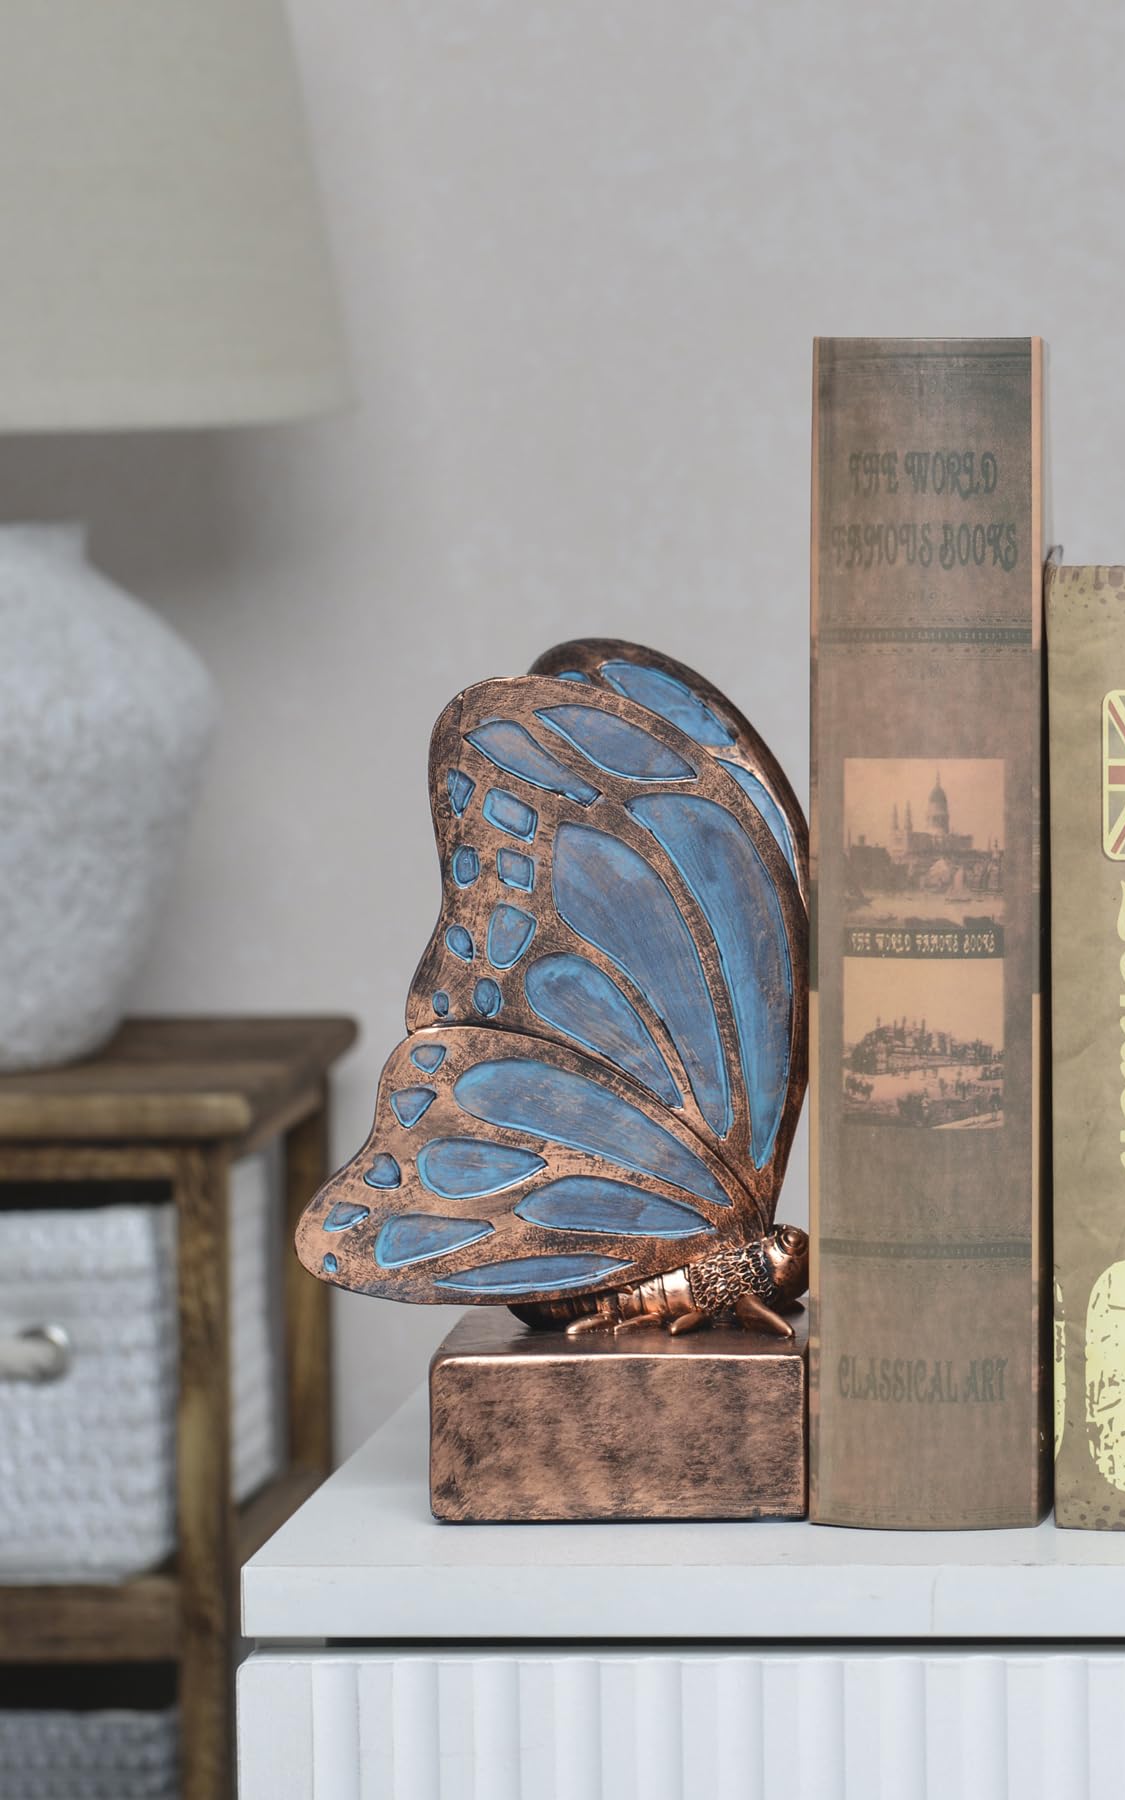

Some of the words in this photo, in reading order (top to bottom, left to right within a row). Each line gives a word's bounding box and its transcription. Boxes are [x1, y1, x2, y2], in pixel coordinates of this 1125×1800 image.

[904, 450, 998, 500] WORLD
[832, 522, 934, 570] FAMOUS
[939, 521, 1018, 572] BOOKS
[837, 1355, 958, 1402] CLASSICAL
[963, 1357, 1009, 1402] ART
